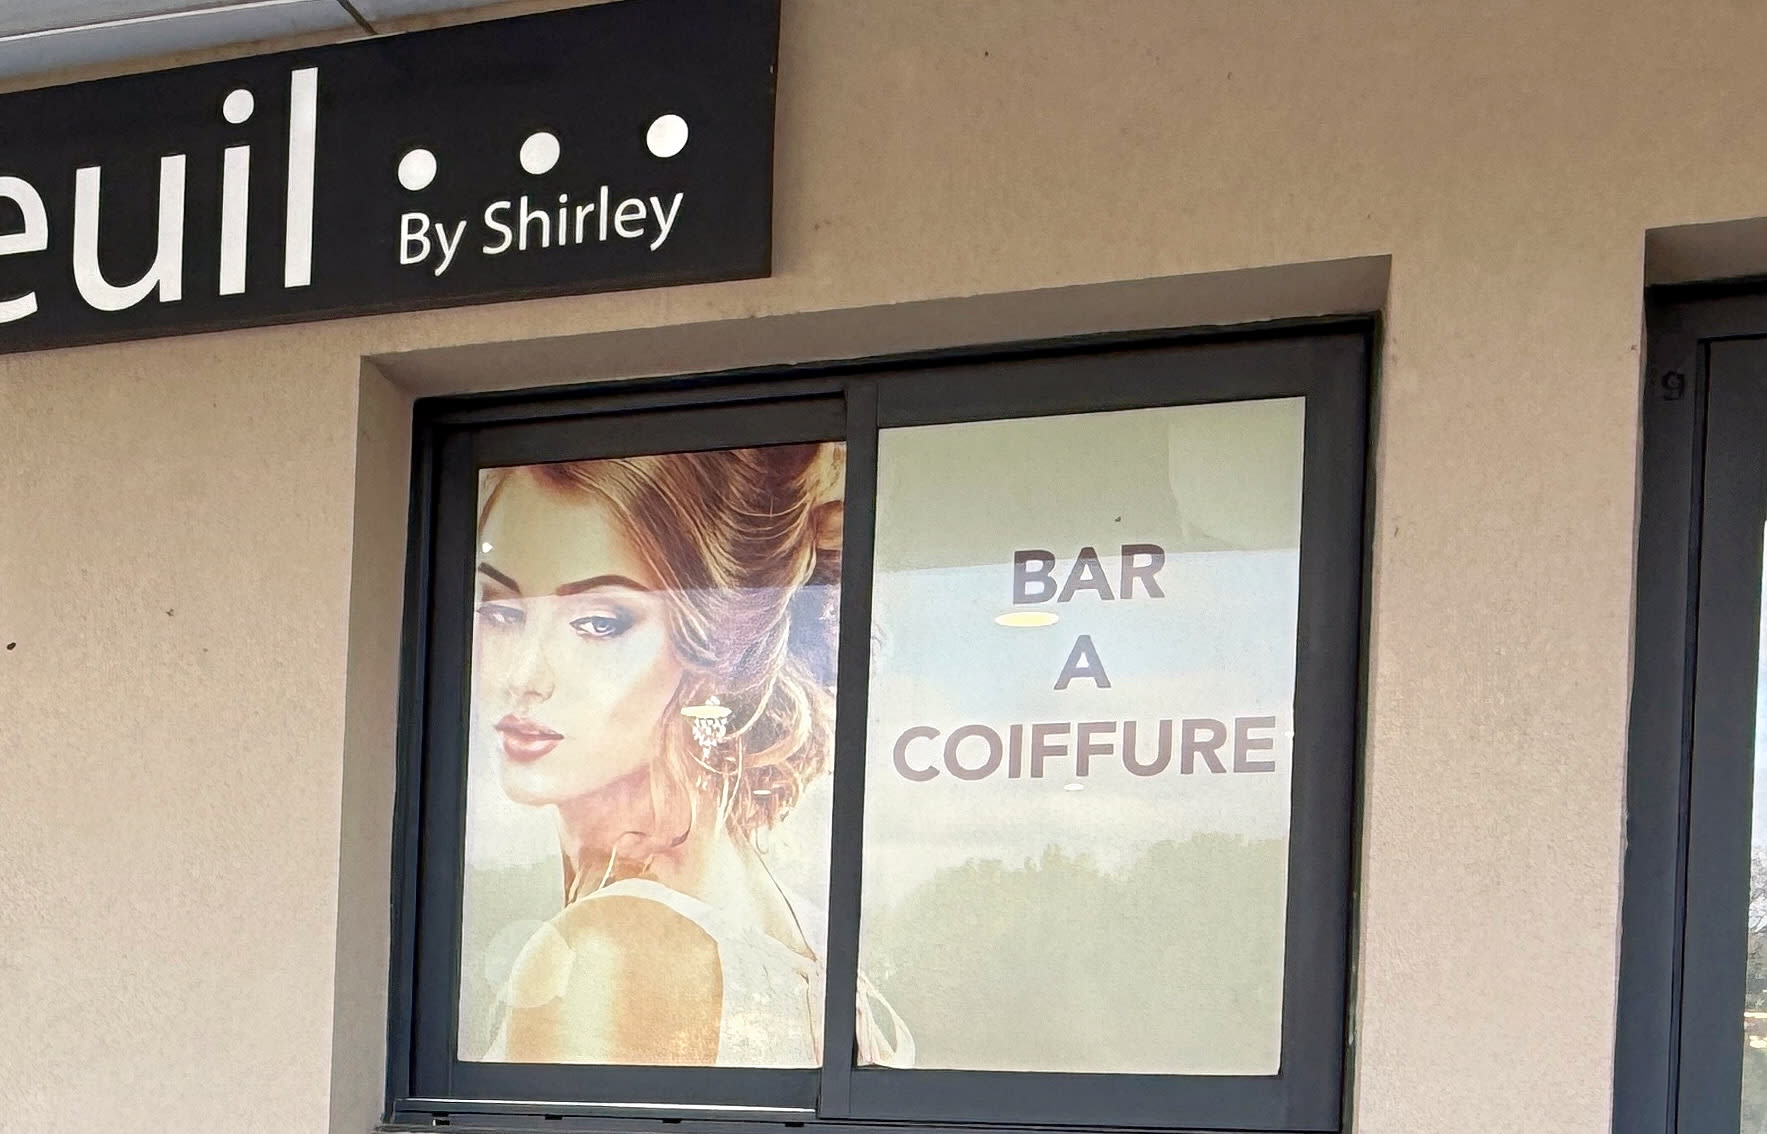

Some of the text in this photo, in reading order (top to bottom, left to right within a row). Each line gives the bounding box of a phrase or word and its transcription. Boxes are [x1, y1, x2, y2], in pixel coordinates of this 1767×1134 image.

[399, 186, 685, 277] By Shirley
[1012, 544, 1166, 605] BAR
[1054, 634, 1111, 690] A
[893, 716, 1276, 782] COIFFURE
